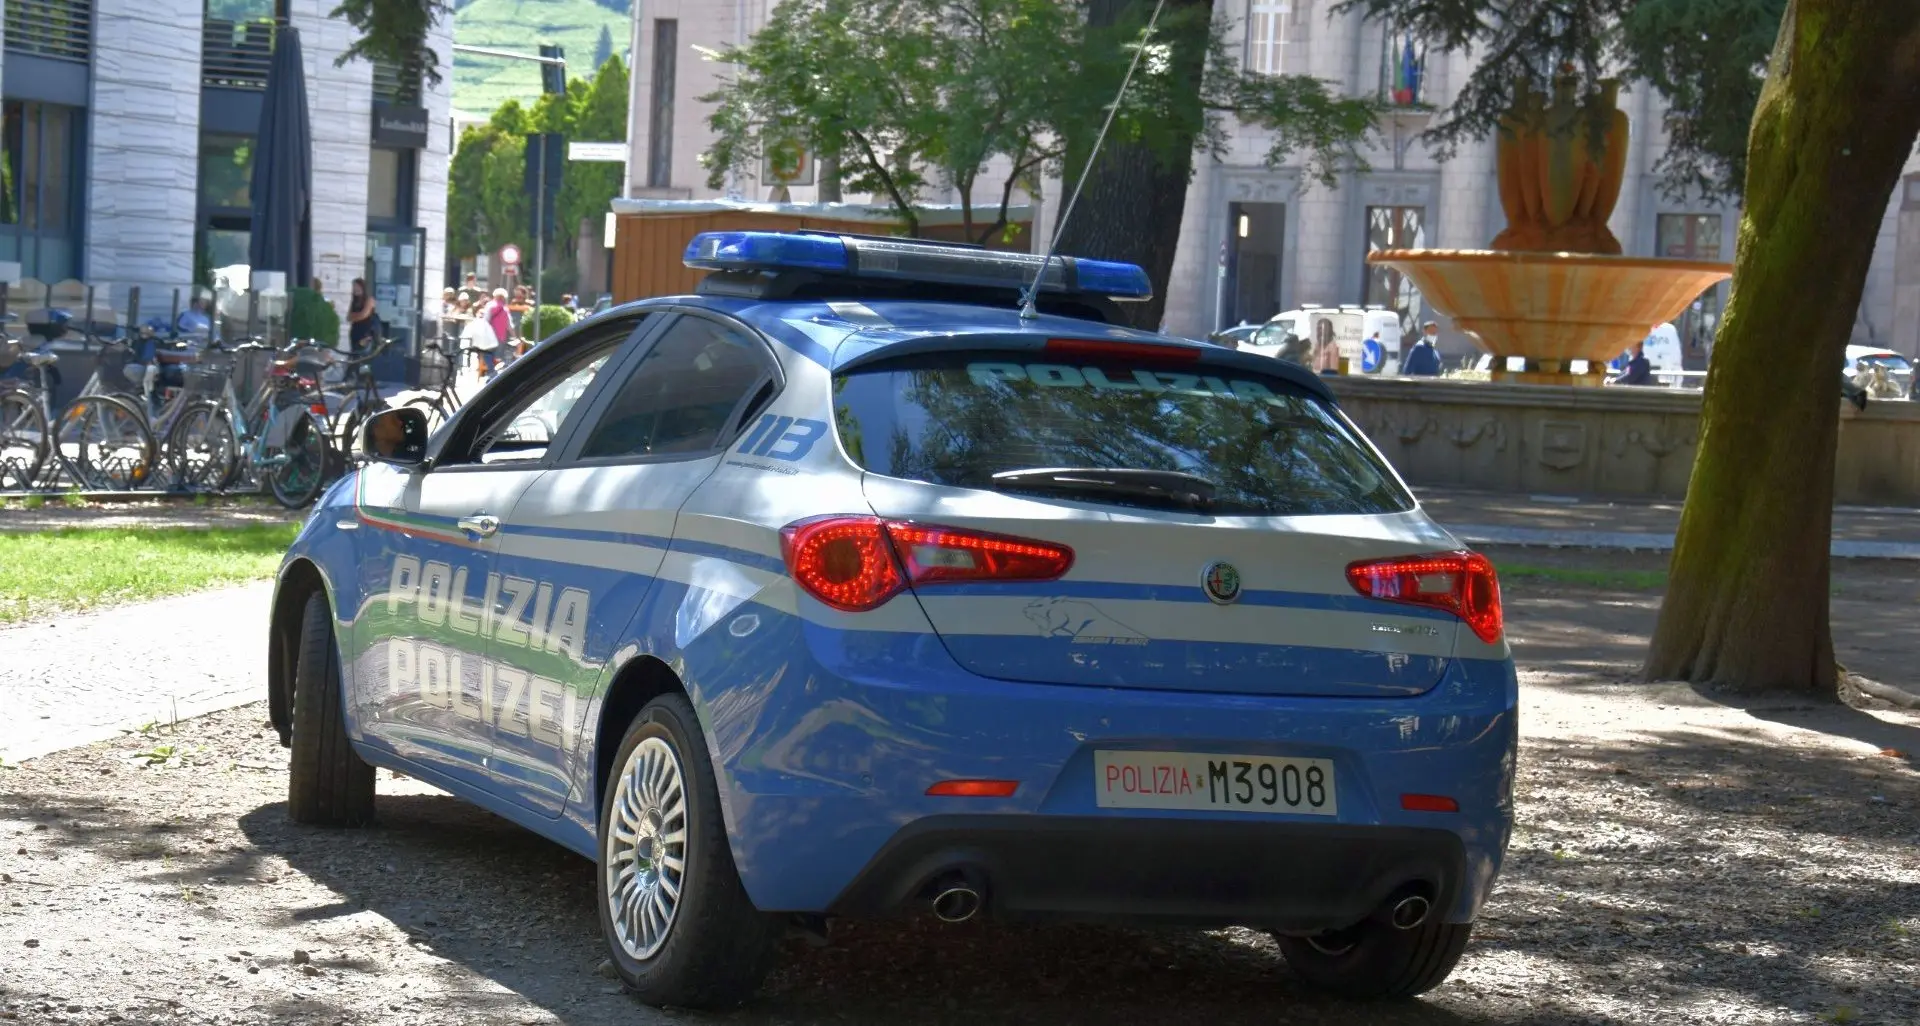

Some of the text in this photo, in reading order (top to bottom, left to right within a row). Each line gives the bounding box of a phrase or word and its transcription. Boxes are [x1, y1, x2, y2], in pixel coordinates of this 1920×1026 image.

[966, 362, 1287, 408] POLIZIA
[736, 413, 828, 461] 113
[387, 553, 591, 662] POLIZIA
[388, 635, 578, 753] POLIZEI
[1106, 760, 1327, 808] POLIZIA M3908
